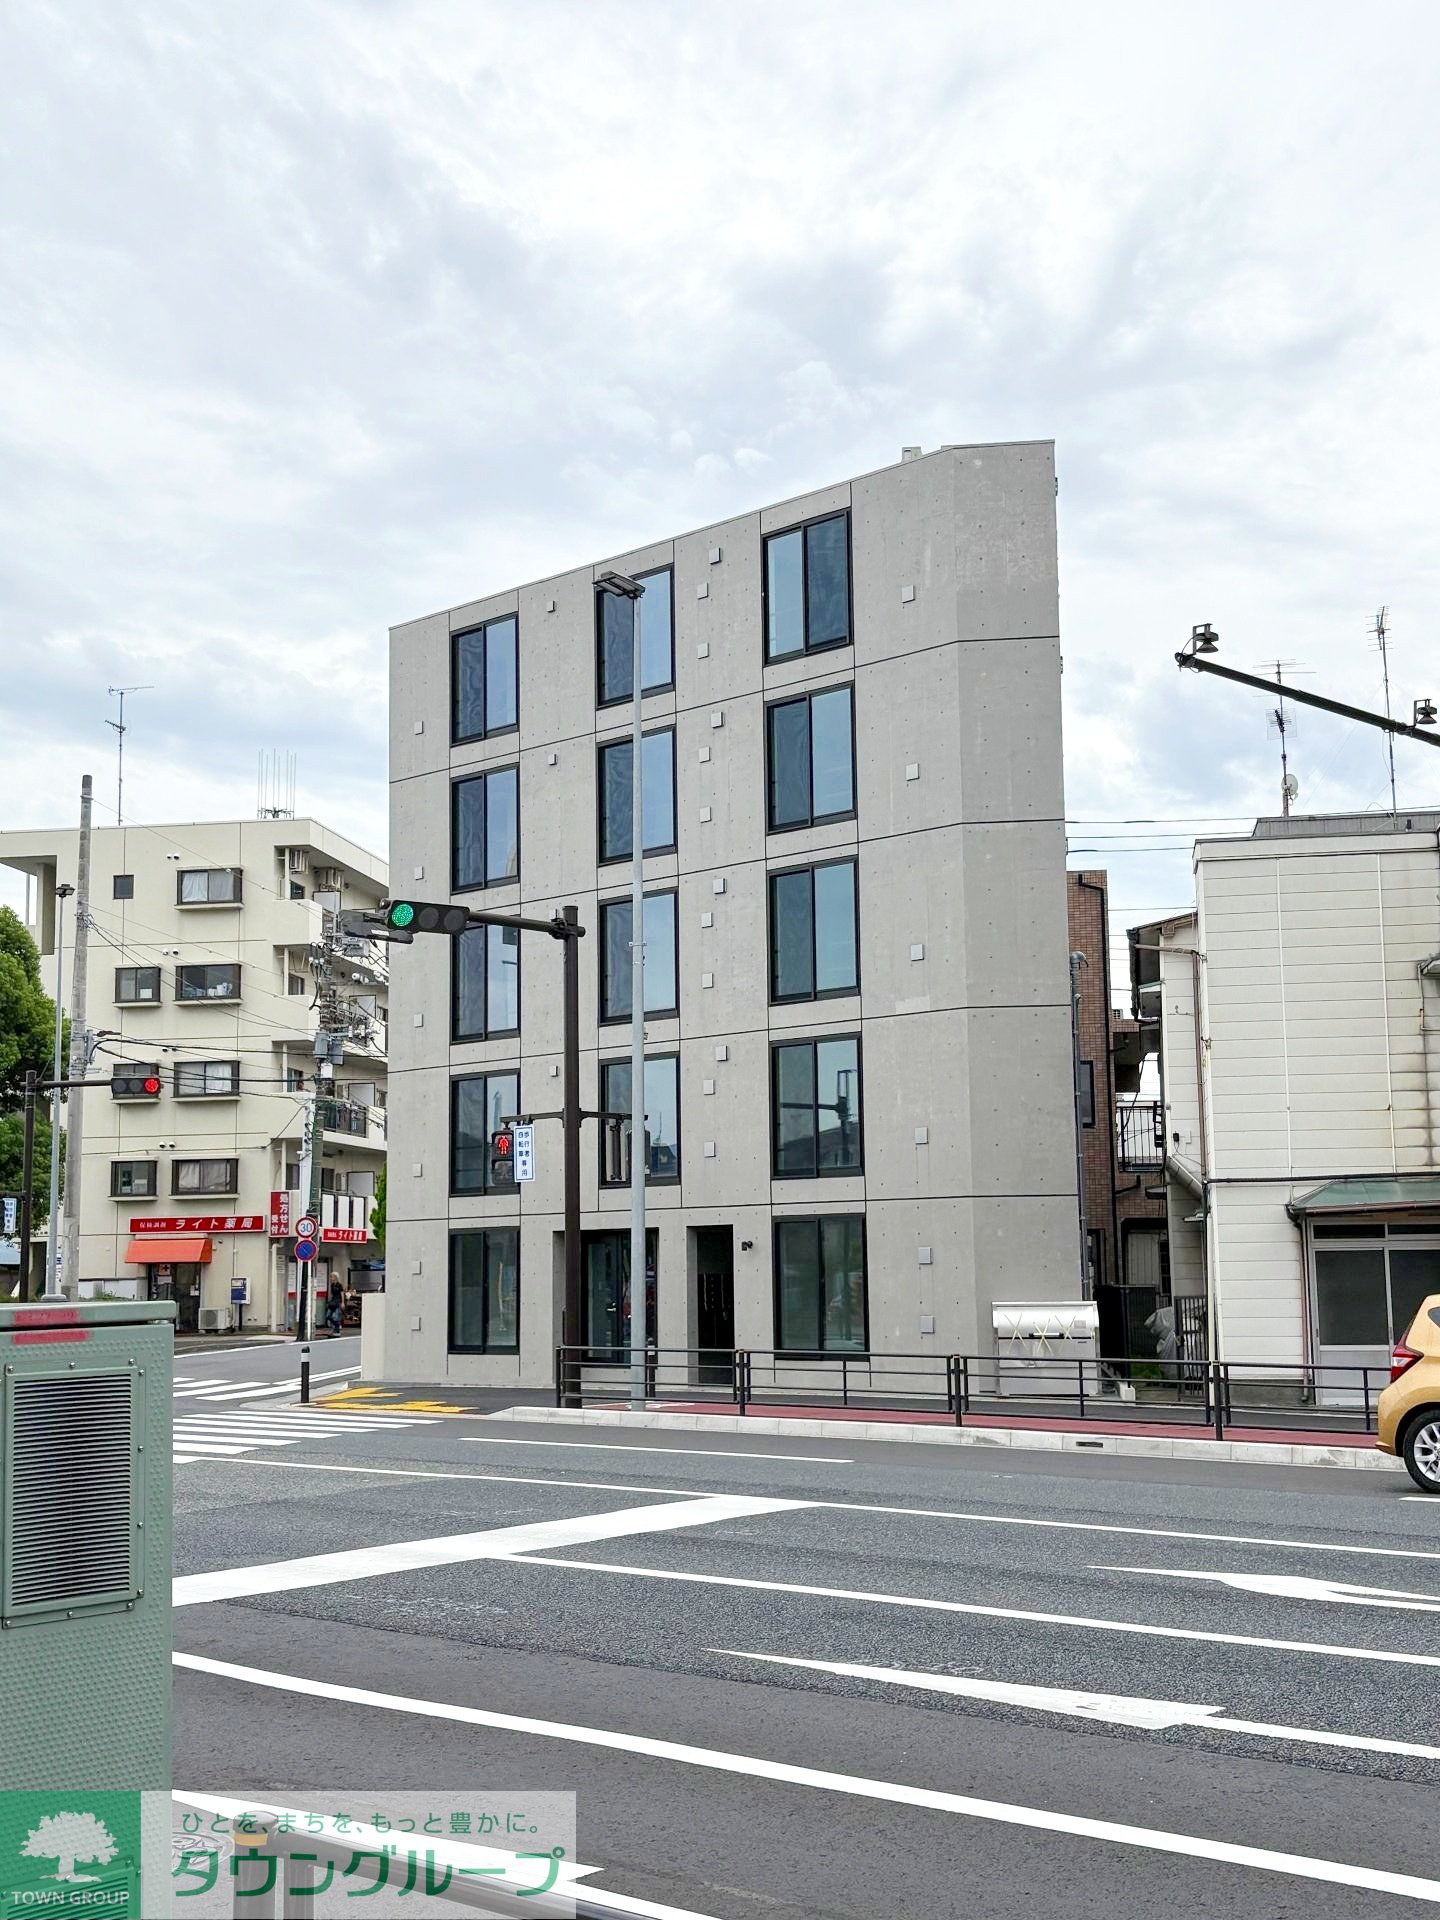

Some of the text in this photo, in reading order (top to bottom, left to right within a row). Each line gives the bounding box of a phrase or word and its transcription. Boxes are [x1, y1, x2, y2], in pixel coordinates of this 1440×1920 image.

[280, 1193, 288, 1233] 処方せん
[175, 1217, 253, 1229] ライト薬局
[300, 1222, 313, 1233] 30
